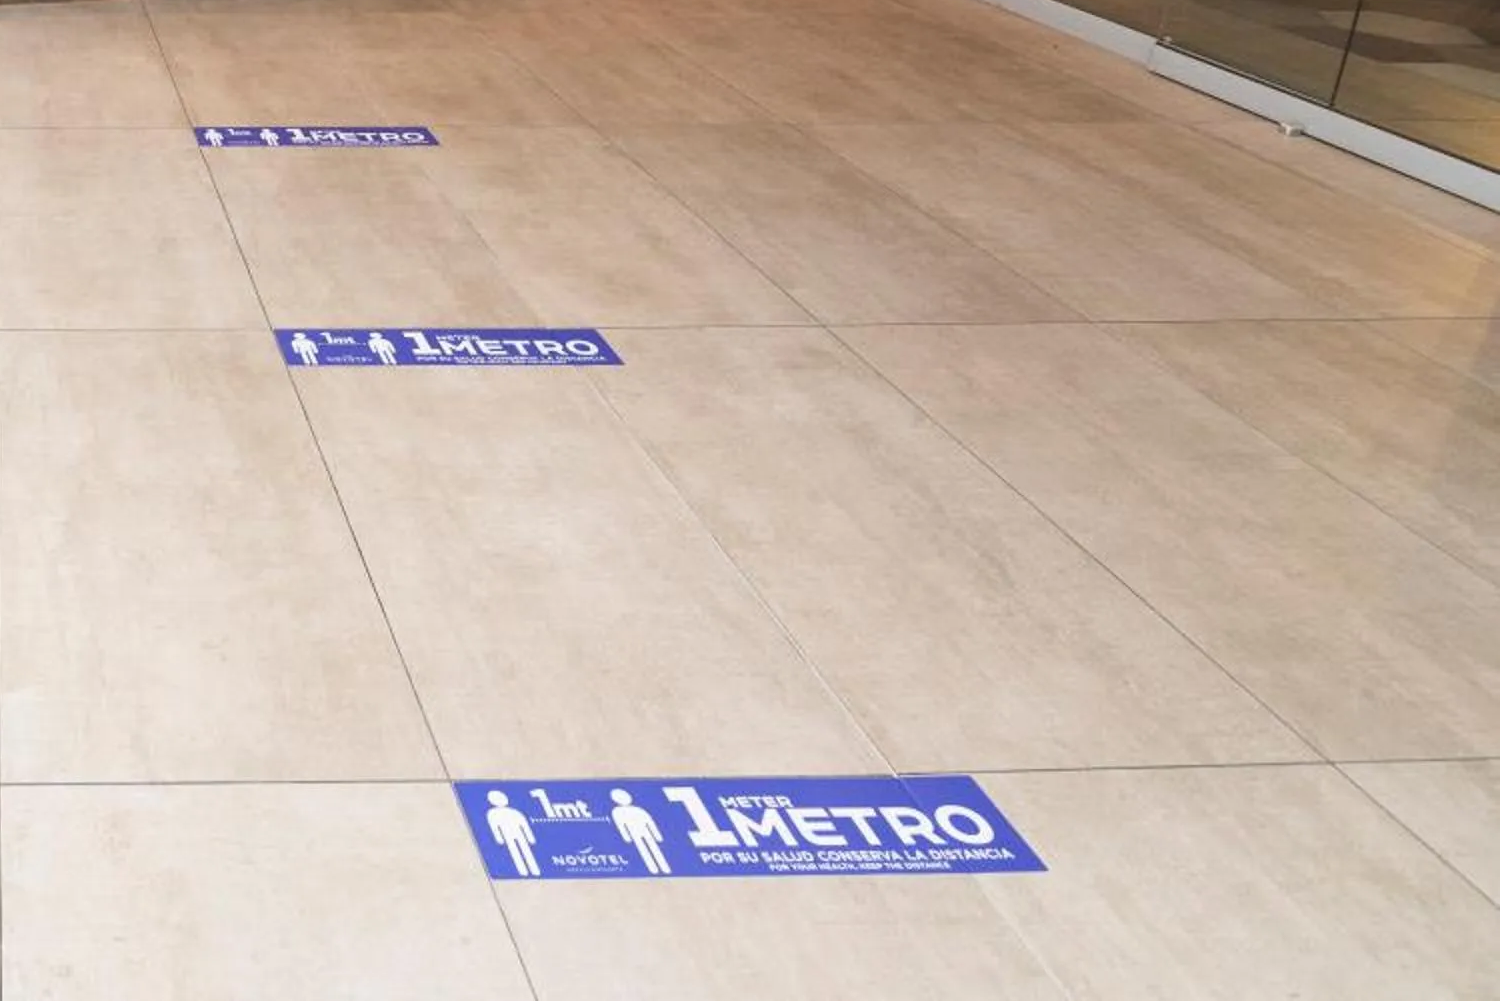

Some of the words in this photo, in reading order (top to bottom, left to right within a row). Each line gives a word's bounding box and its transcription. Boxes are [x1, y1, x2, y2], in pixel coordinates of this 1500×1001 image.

[310, 131, 425, 142] METRO
[402, 331, 442, 355] 1
[438, 340, 599, 356] METRO
[528, 788, 593, 819] 1mt
[718, 795, 793, 809] METER
[662, 786, 740, 848] 1
[726, 805, 996, 847] METRO
[552, 854, 628, 866] NOVOTEL
[700, 852, 736, 864] POR
[737, 852, 760, 864] SU
[761, 850, 815, 863] SALUD
[817, 849, 904, 863] CONSERVA
[905, 850, 928, 861] LA
[929, 848, 1016, 861] DISTANCIA
